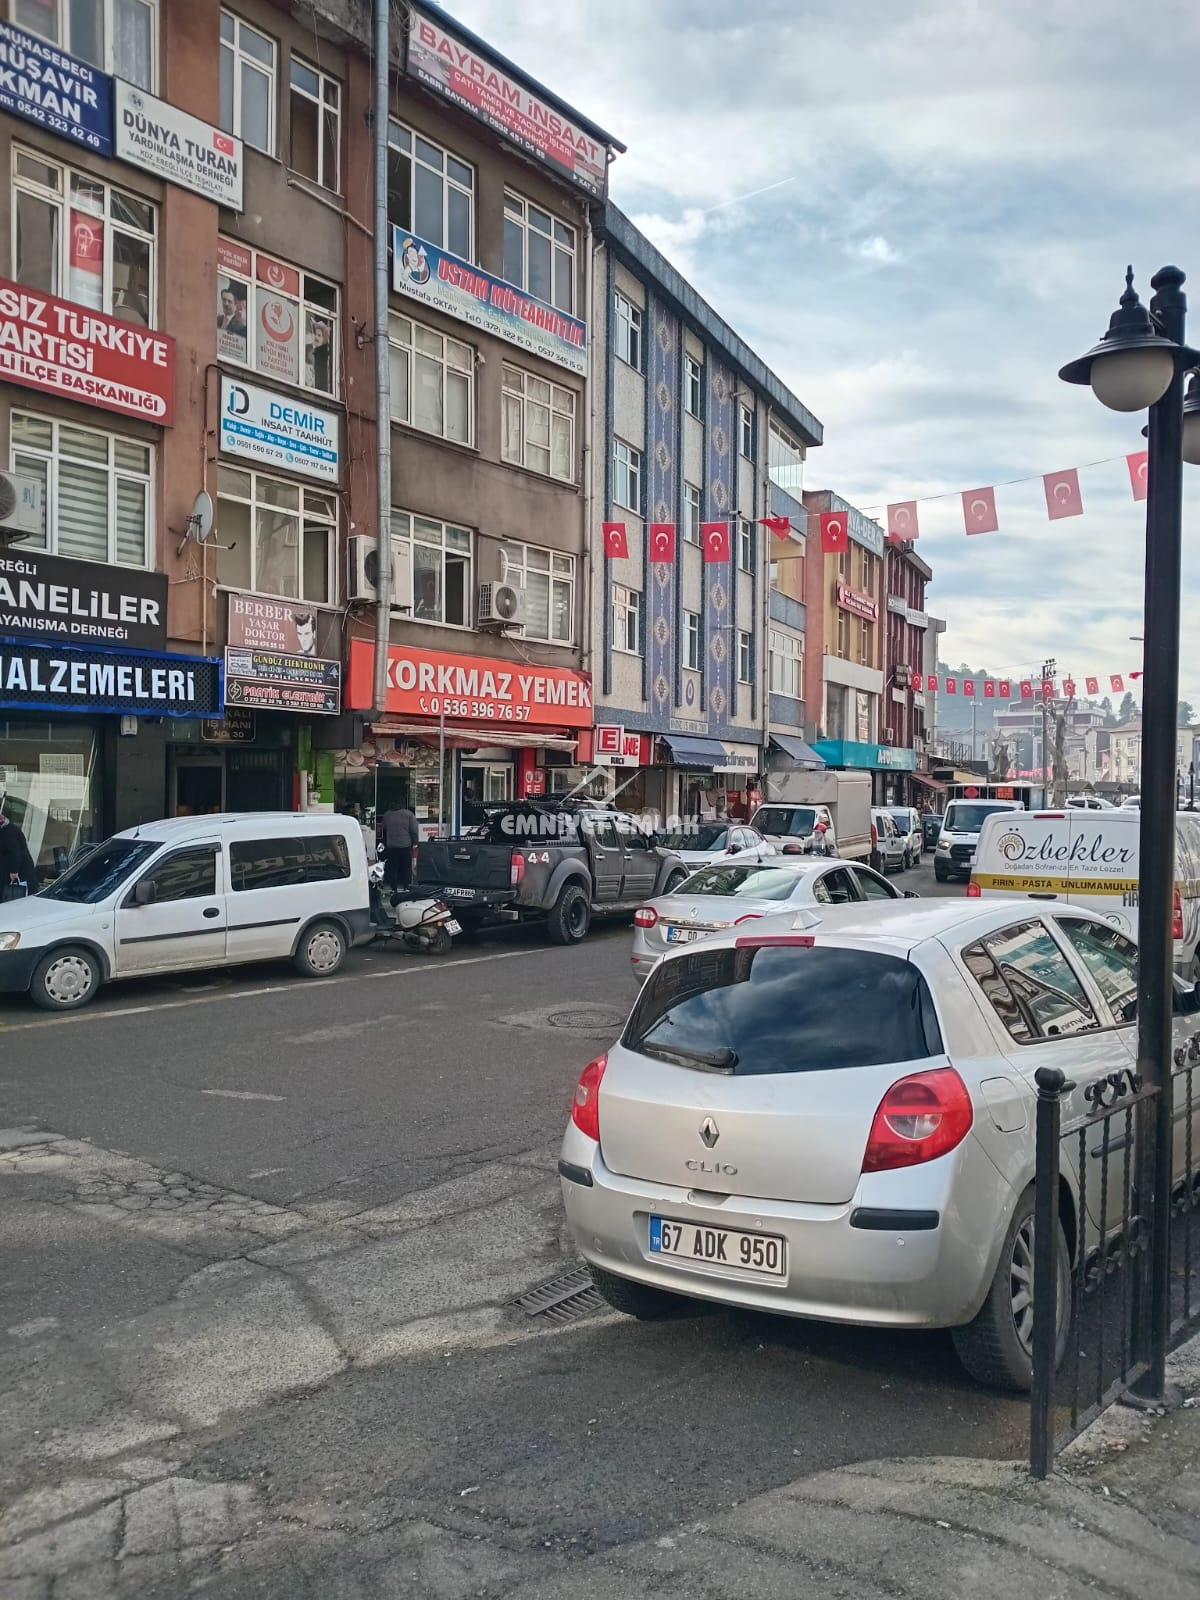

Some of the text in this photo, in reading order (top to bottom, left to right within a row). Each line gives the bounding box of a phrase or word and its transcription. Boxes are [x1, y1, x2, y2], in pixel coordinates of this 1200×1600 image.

[420, 22, 520, 107] BAYRAM
[445, 87, 479, 114] BAYRAM
[454, 72, 475, 91] ÇATI
[504, 104, 515, 117] VE
[17, 100, 45, 121] 0542
[48, 114, 68, 132] 323
[71, 126, 85, 140] 42
[87, 132, 100, 147] 49
[123, 109, 238, 178] DÜNYA TURAN
[129, 131, 194, 169] YARDIMLAŞMA
[400, 281, 431, 302] Mustafa
[433, 295, 458, 314] OKTAY
[437, 257, 491, 302] USTAM
[0, 320, 94, 374] ARTİSİ
[53, 305, 168, 367] TÜRKİYE
[20, 356, 57, 381] İLÇE
[61, 371, 159, 412] BAŞKANLIĞI
[270, 402, 325, 434] DEMİR
[234, 600, 293, 622] BERBER
[249, 618, 280, 632] YAŞAR
[71, 623, 128, 640] DERNEĞİ
[244, 627, 286, 642] DOKTOR
[0, 655, 195, 701] ALZEMELERİ
[386, 658, 592, 708] KORKMAZ YEMEK
[430, 697, 531, 721] 0 536 396 76 57
[997, 827, 1135, 863] Özbekler
[992, 879, 1015, 887] FIRIN
[1022, 880, 1053, 888] PASTA
[685, 1159, 738, 1176] CLIO
[661, 1223, 778, 1269] 67 ADK 950
